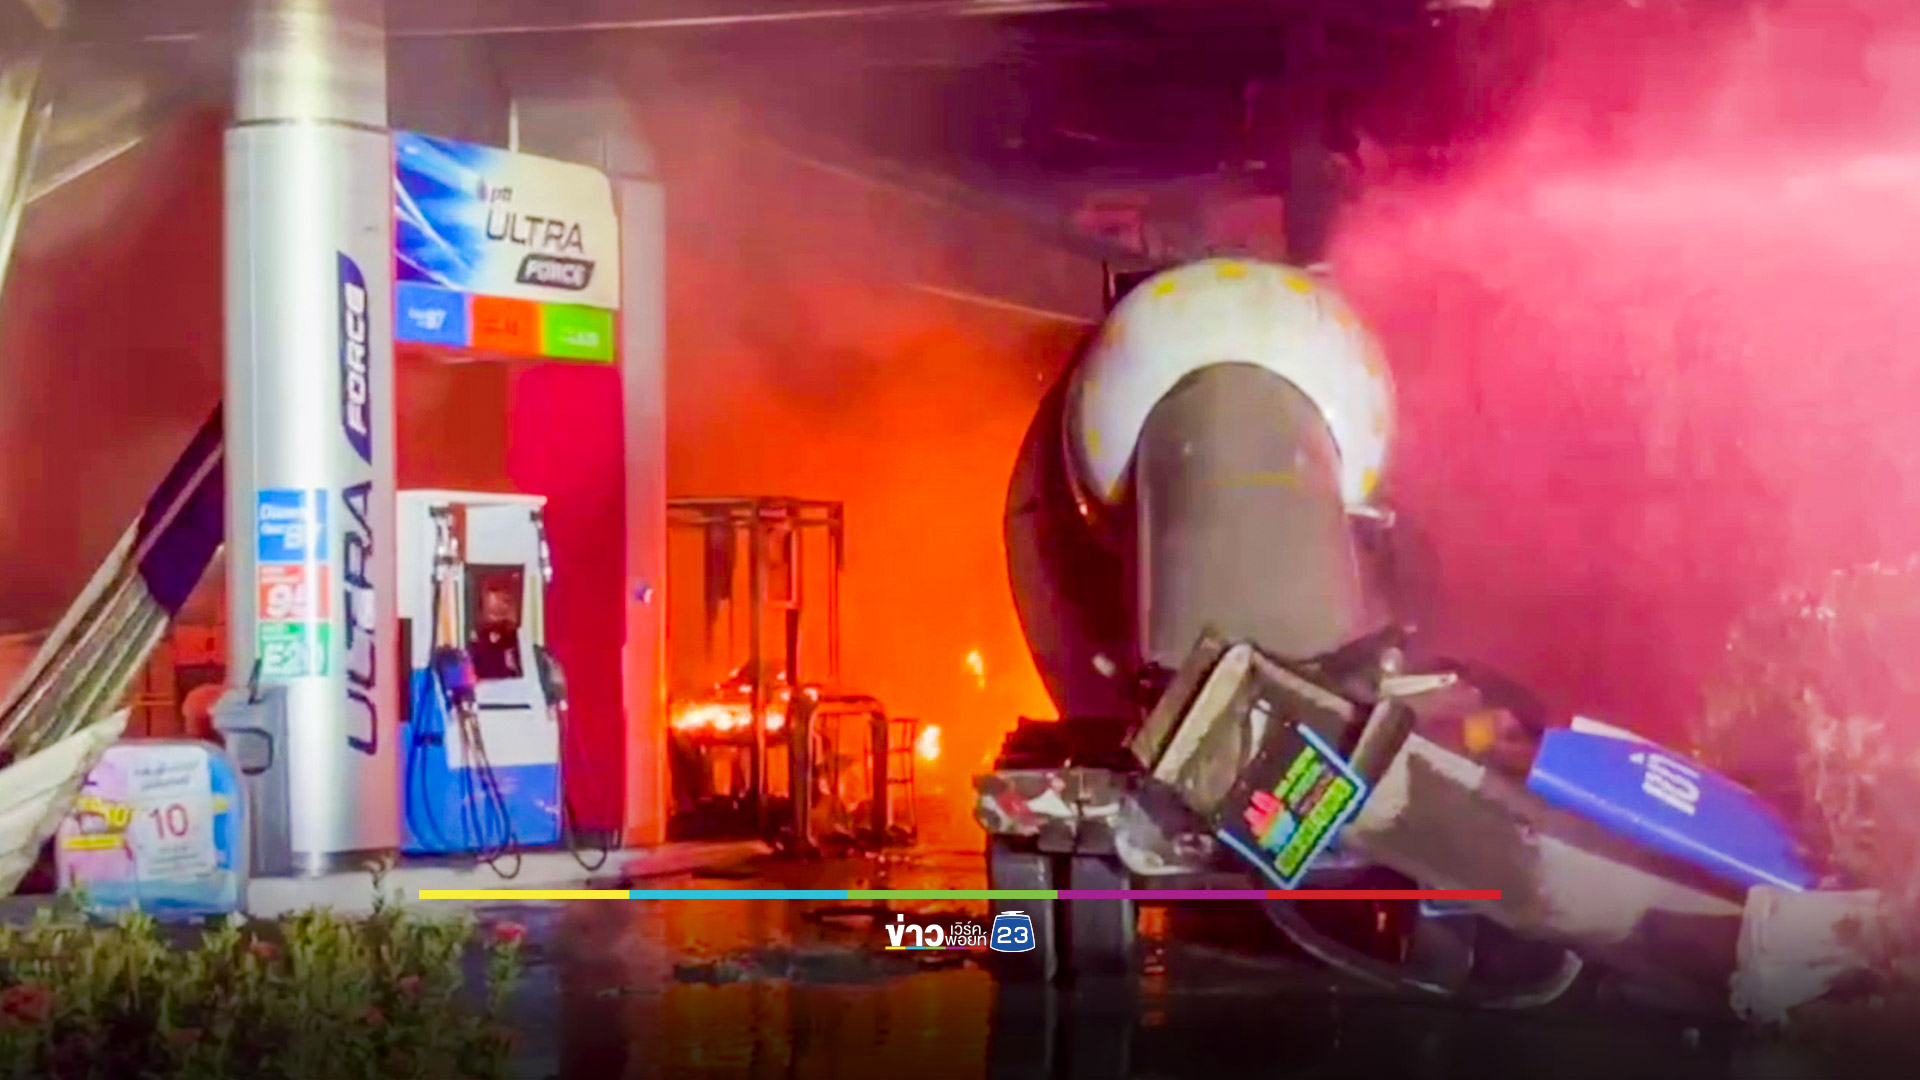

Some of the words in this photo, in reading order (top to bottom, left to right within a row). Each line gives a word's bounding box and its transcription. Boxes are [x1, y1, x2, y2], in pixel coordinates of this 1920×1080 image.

[487, 208, 584, 253] ULTRA
[524, 260, 587, 285] FORCE
[344, 281, 367, 436] FORCE
[342, 480, 377, 755] ULTRA
[149, 803, 189, 840] 10
